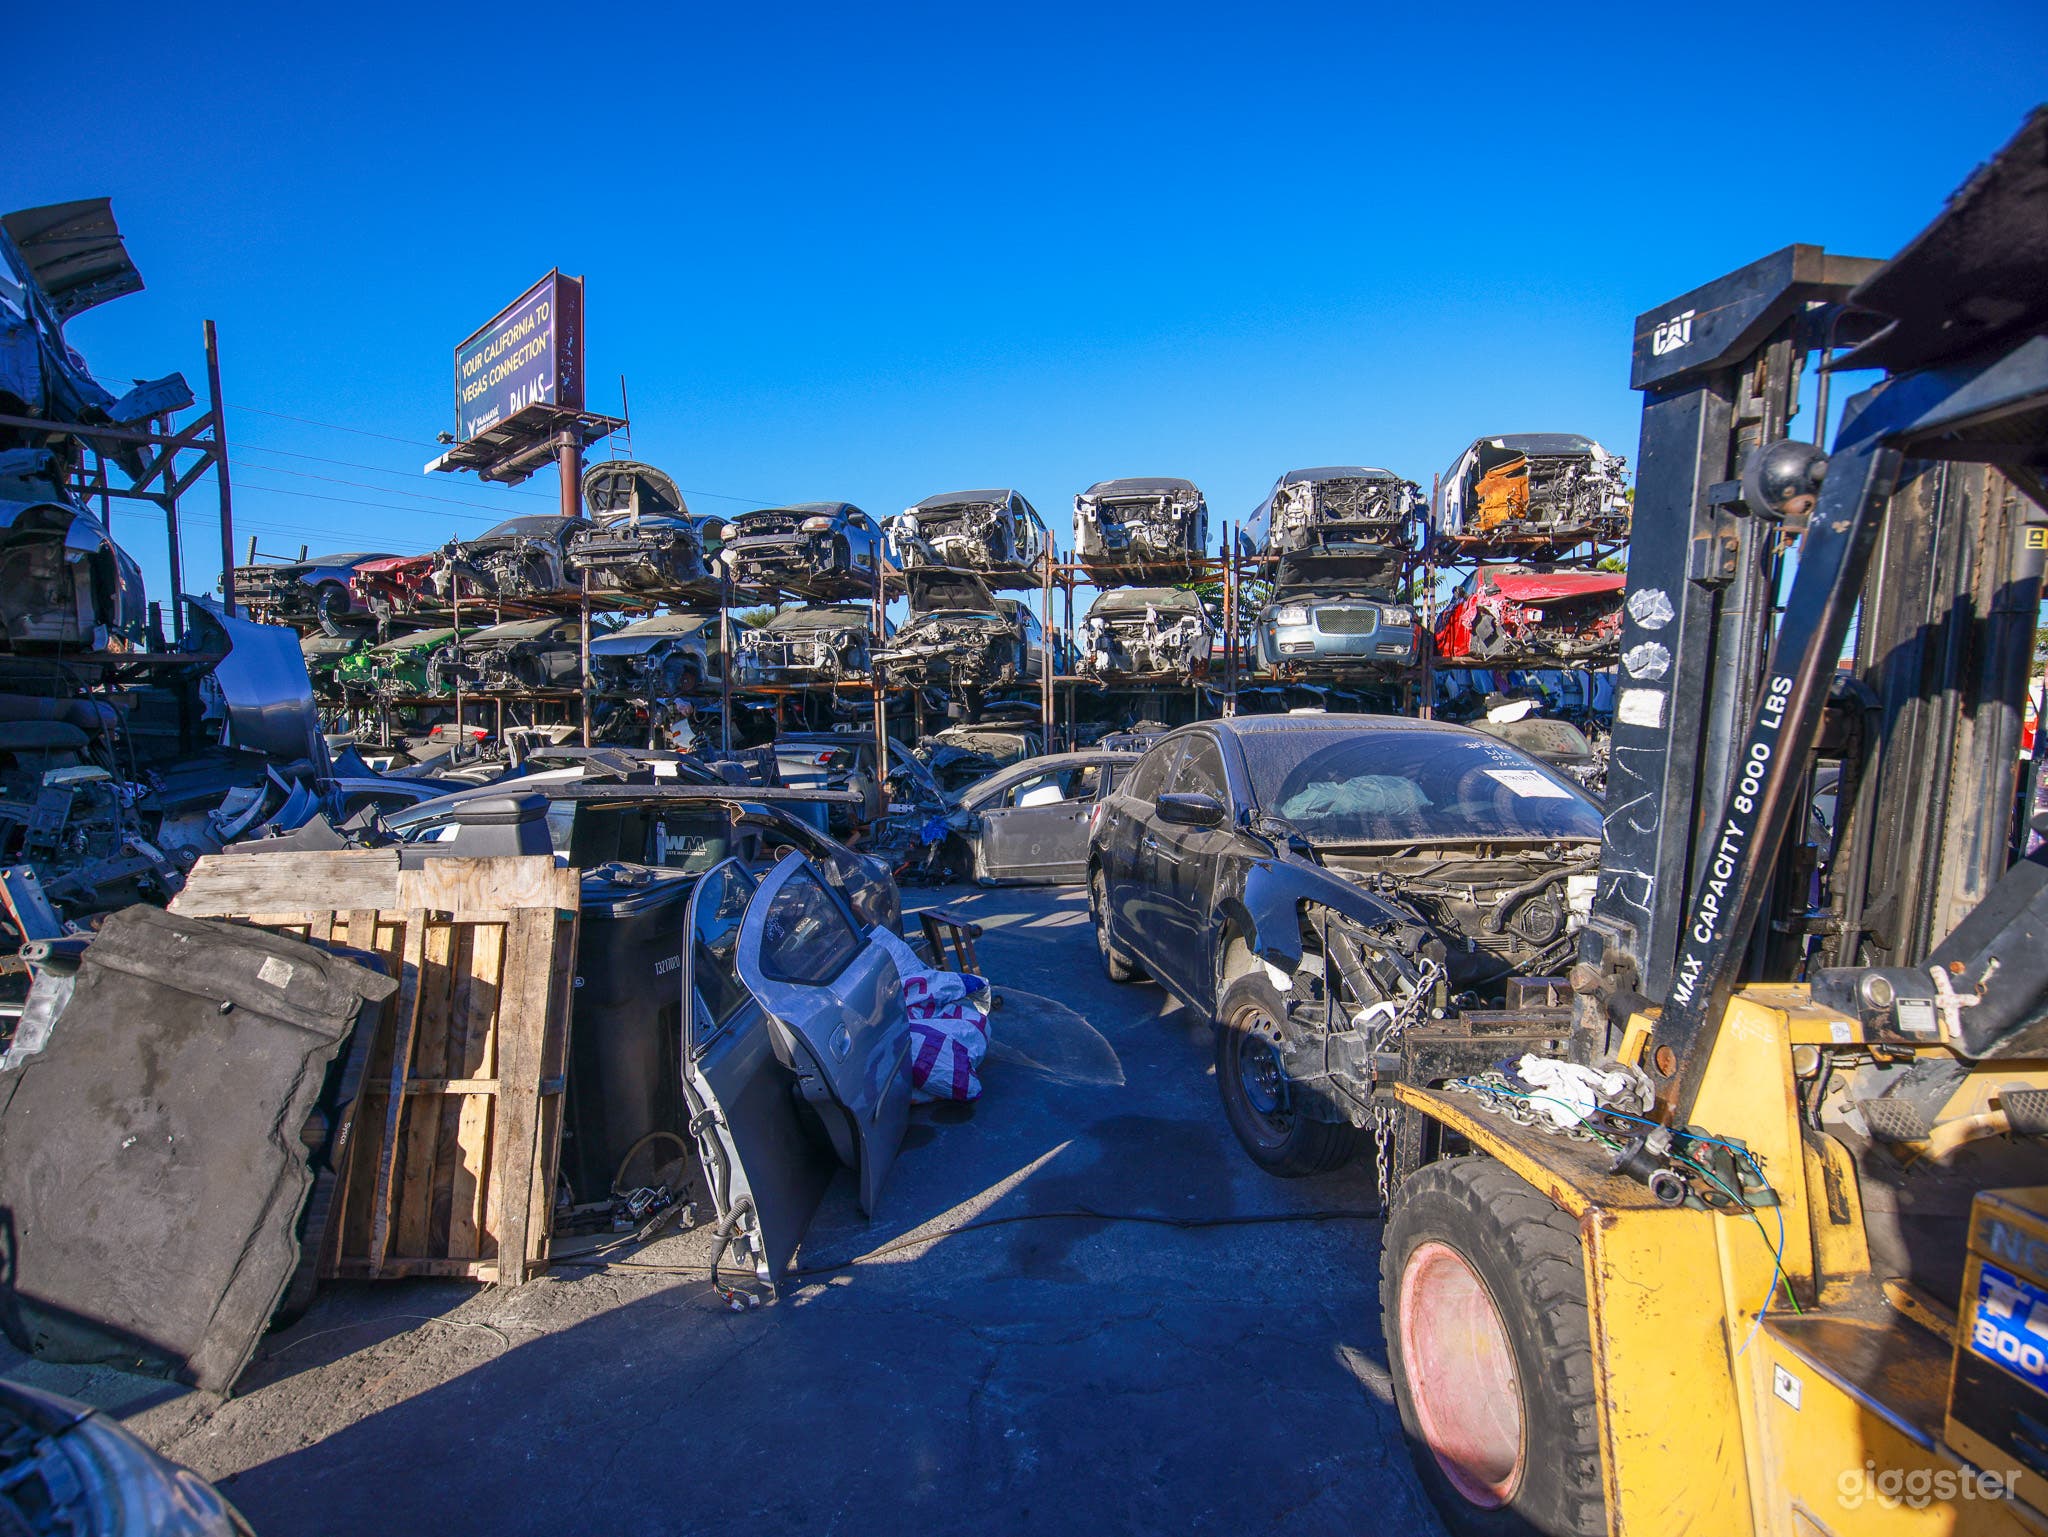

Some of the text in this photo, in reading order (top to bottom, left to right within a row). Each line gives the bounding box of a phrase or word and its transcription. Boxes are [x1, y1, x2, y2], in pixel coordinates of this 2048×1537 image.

[462, 301, 549, 380] YOUR CALIFORNIA TO
[1652, 309, 1696, 357] CAT
[462, 374, 488, 405] VEGAS
[1673, 676, 1793, 1008] MAX CAPACITY 8000 LBS
